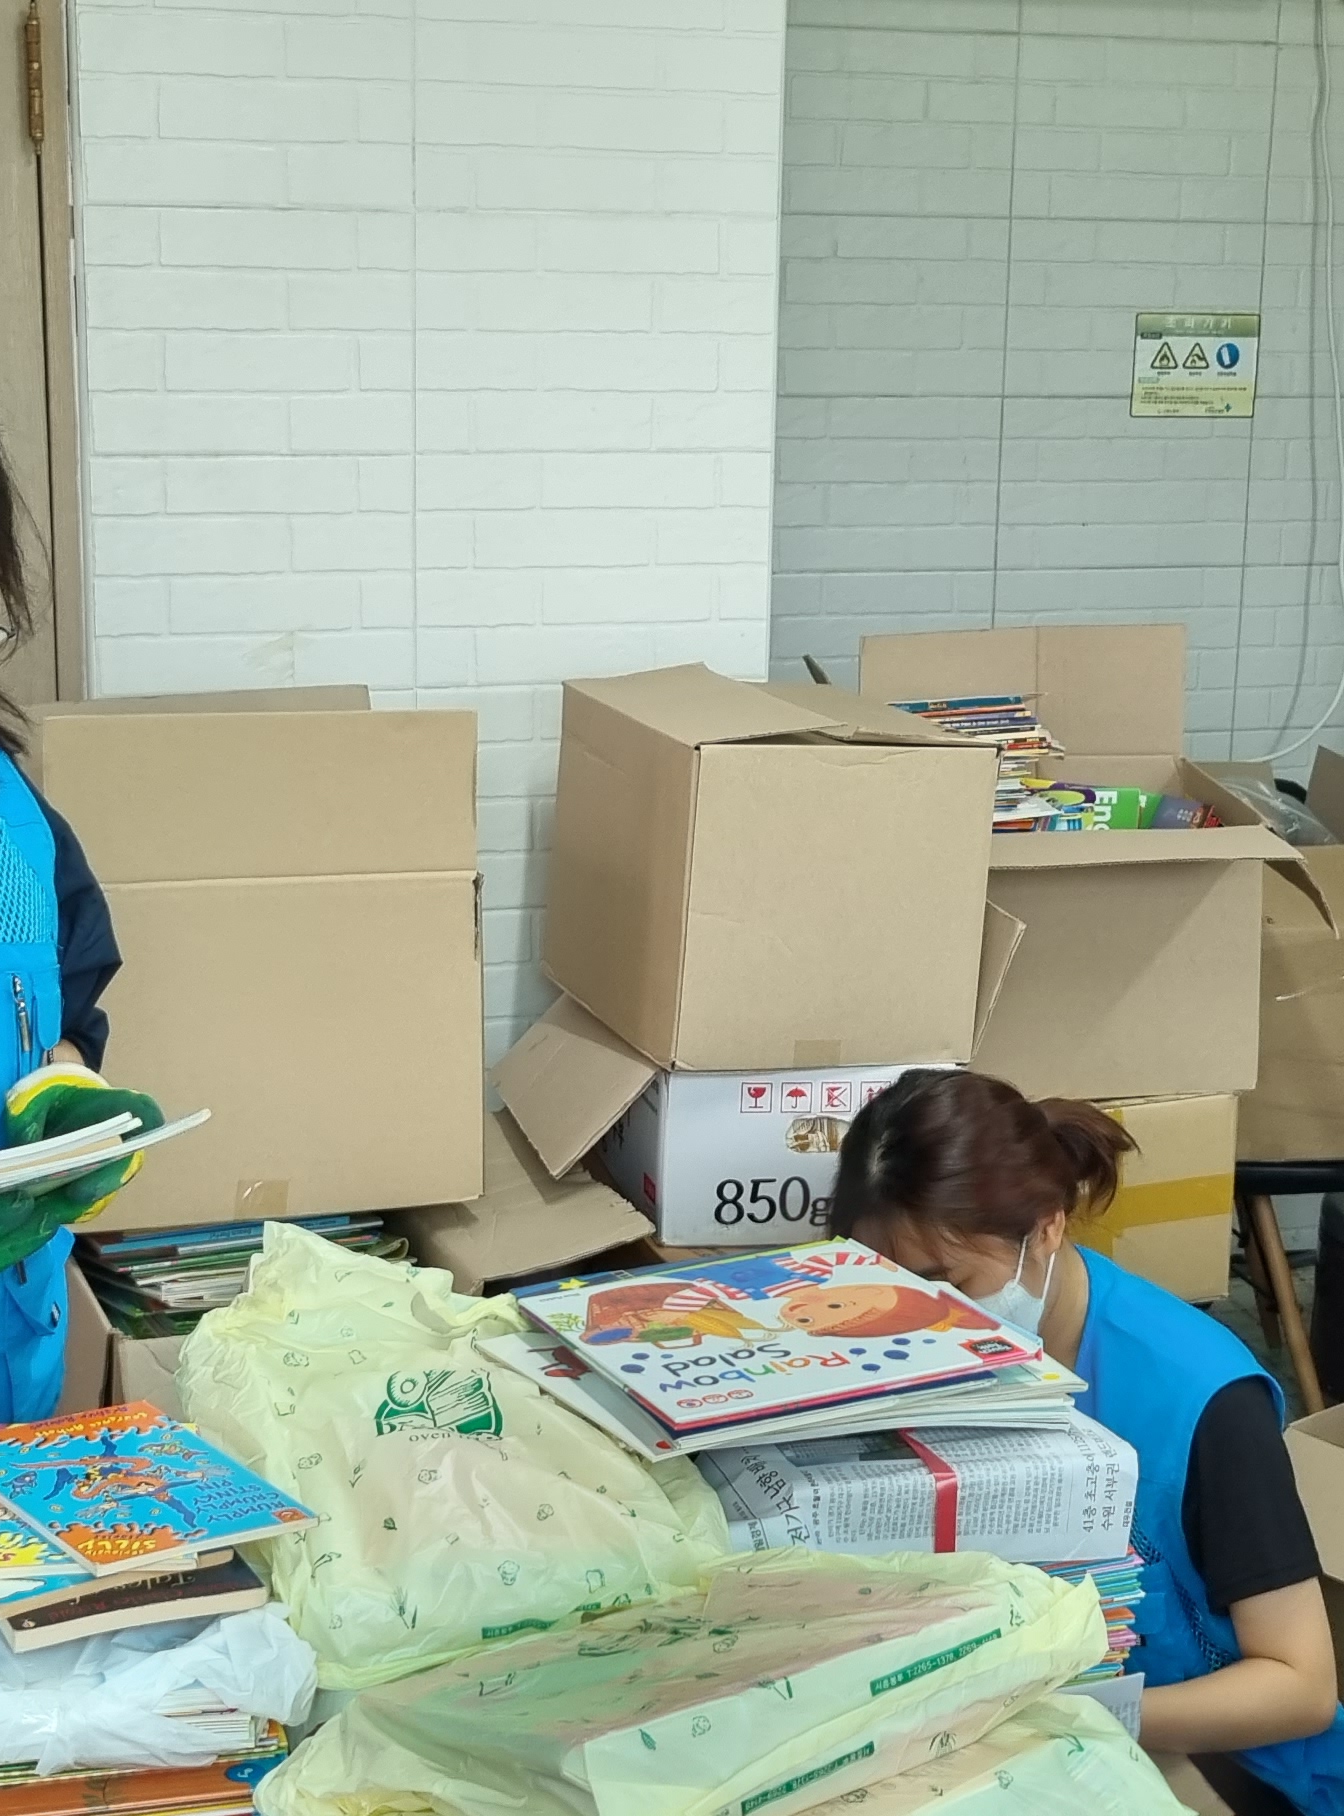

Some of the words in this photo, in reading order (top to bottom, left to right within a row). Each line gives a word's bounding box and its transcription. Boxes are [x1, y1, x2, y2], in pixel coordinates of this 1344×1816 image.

[713, 1175, 833, 1227] 850g
[659, 1350, 851, 1393] Rainbow
[661, 1342, 792, 1378] Salad
[193, 1484, 261, 1505] STINKY
[196, 1479, 233, 1491] PIN
[196, 1491, 279, 1514] CRUMPLY
[207, 1500, 286, 1523] RUMPLY
[1100, 1505, 1116, 1532] 수원
[77, 1538, 156, 1550] SILLY
